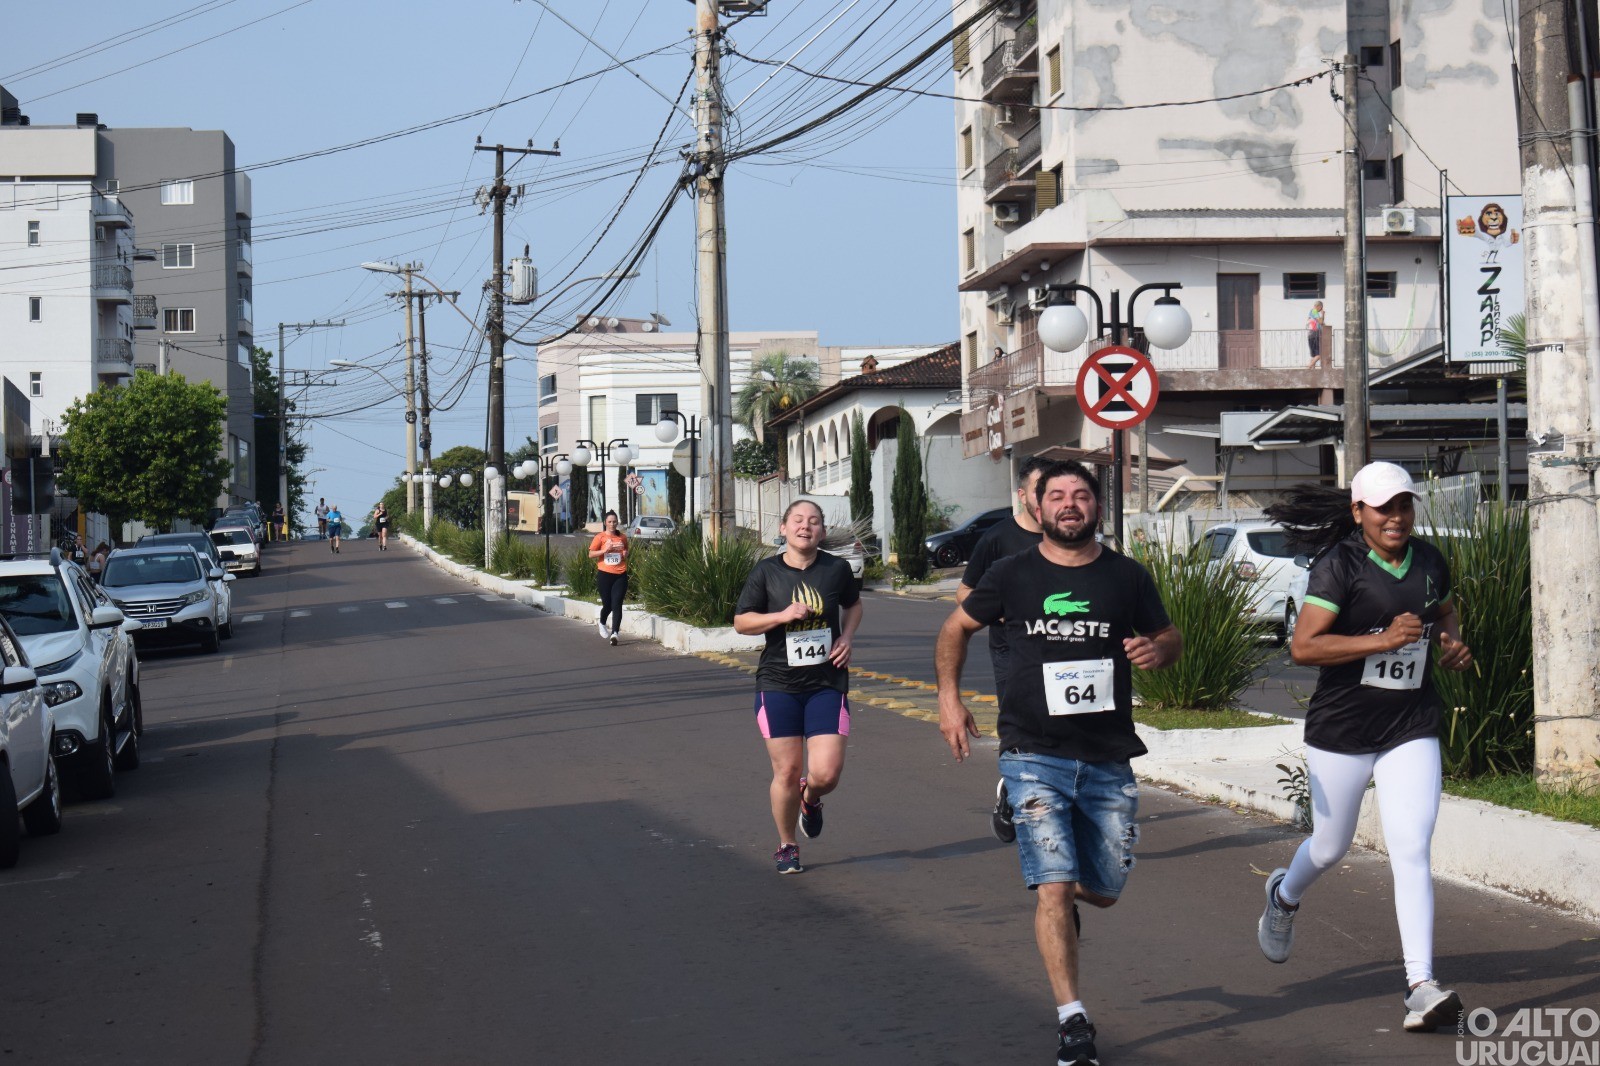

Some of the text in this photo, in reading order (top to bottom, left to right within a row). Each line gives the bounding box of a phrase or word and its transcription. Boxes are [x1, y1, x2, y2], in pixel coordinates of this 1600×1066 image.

[1477, 266, 1502, 347] ZAAP
[795, 643, 827, 660] 144
[1375, 660, 1416, 680] 161
[1064, 683, 1097, 705] 64
